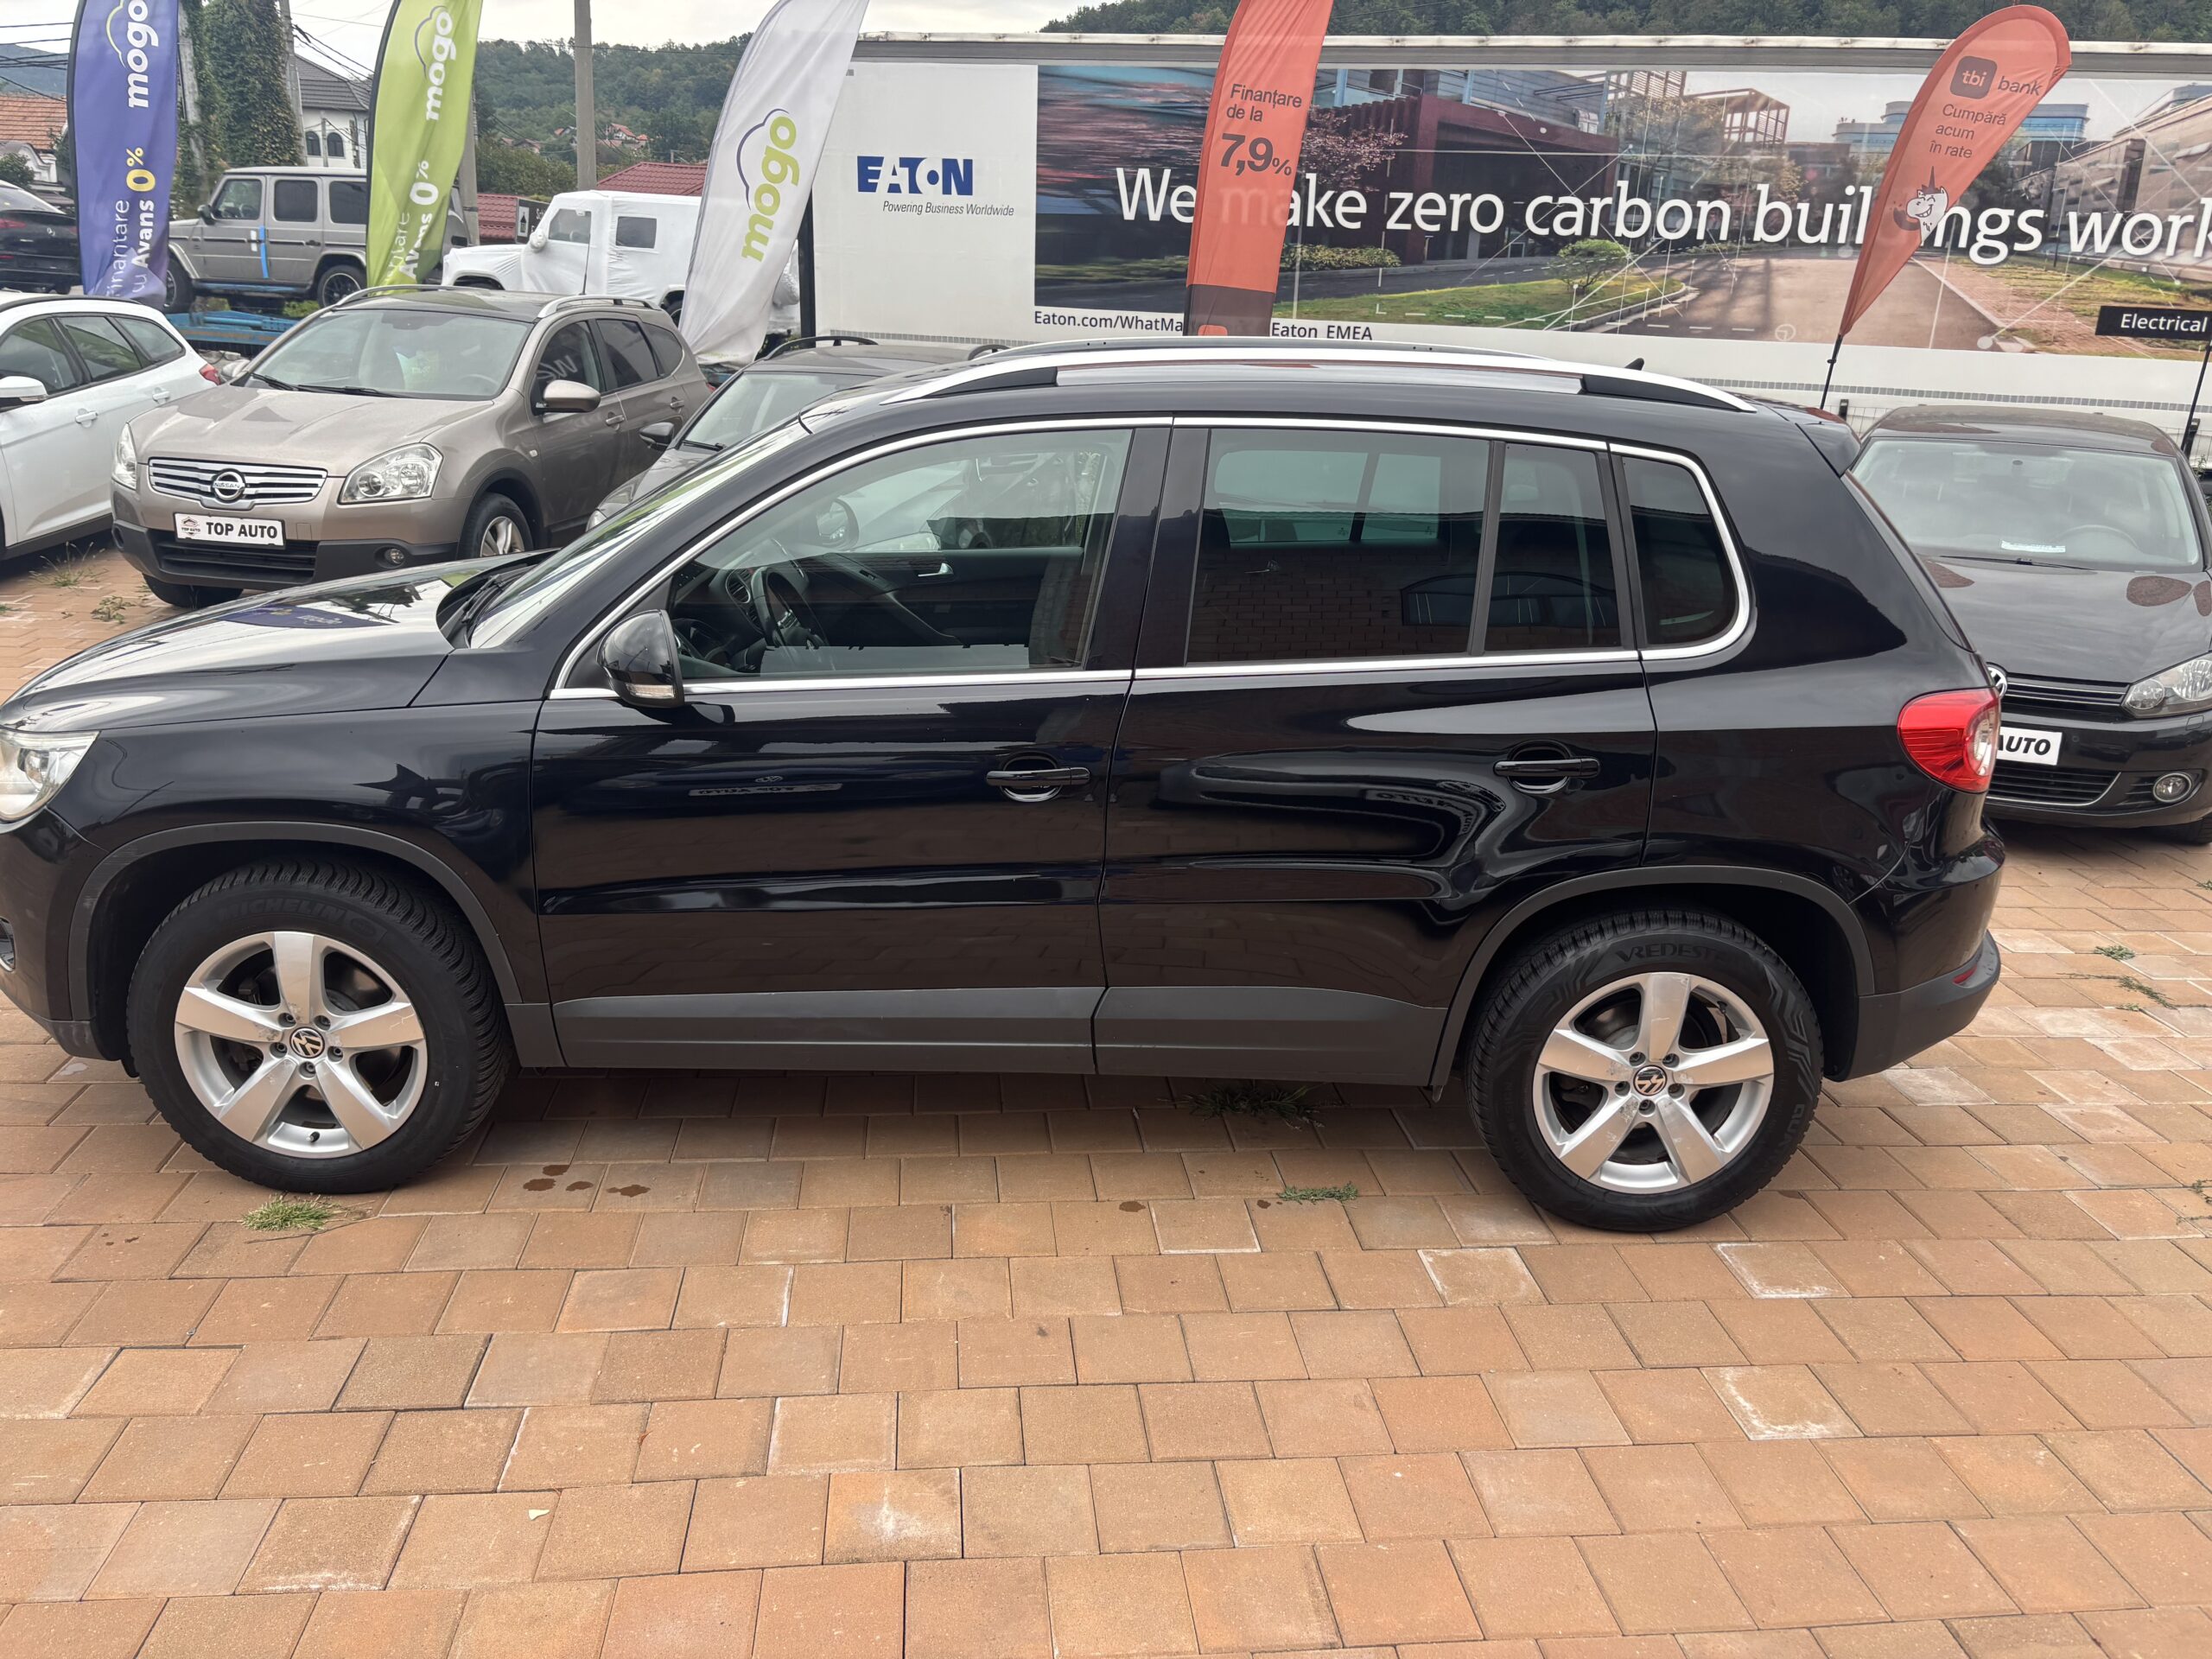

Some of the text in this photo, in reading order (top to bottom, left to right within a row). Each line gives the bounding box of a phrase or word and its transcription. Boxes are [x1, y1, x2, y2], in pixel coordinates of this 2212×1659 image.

[127, 0, 159, 108] mogo
[426, 10, 456, 121] mogo
[1230, 83, 1302, 109] Finanțare
[1962, 70, 2044, 96] tbi bank
[1227, 104, 1263, 122] de la
[1942, 104, 2007, 125] Cumpără
[1936, 124, 1975, 140] acum
[1221, 132, 1292, 176] 7,9%
[1929, 141, 1973, 159] în rate
[857, 156, 974, 196] EATON
[741, 116, 800, 263] mogo
[882, 200, 1014, 216] Powering Business Worldwide
[1116, 167, 1197, 223] We
[1386, 190, 1504, 234] zero
[1525, 180, 1732, 242] carbon
[1752, 183, 2045, 266] builngs
[131, 200, 155, 269] Avans
[1272, 322, 1318, 339] Eaton
[1326, 325, 1373, 340] EMEA
[2120, 313, 2209, 333] Electrical
[206, 522, 278, 539] TOP AUTO
